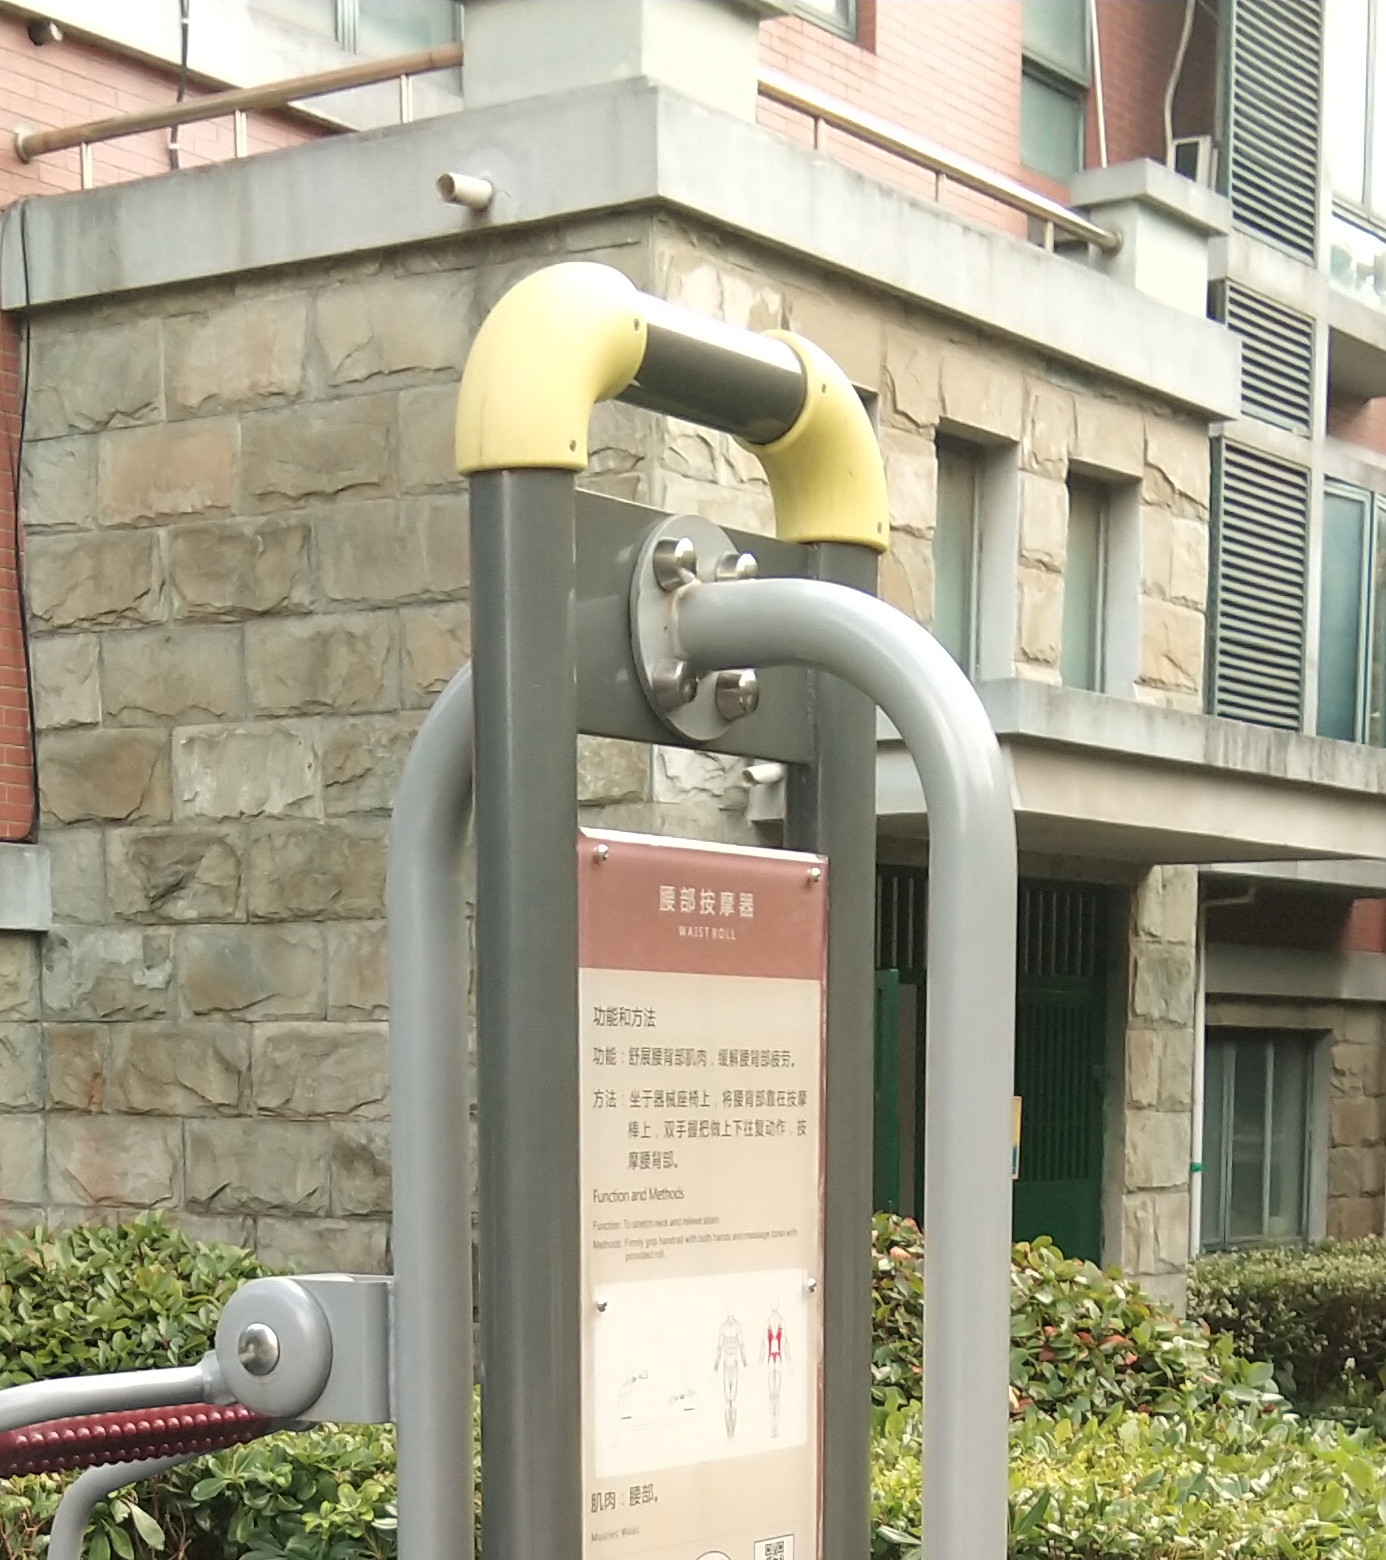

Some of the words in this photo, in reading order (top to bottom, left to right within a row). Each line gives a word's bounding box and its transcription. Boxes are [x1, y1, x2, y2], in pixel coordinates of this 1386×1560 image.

[659, 885, 754, 918] 腰部按摩器
[678, 926, 710, 938] WAIST
[712, 929, 736, 940] ROLL
[593, 1007, 656, 1028] 功能和方法
[593, 1188, 630, 1204] Function
[631, 1187, 648, 1202] and
[649, 1185, 685, 1201] Methods
